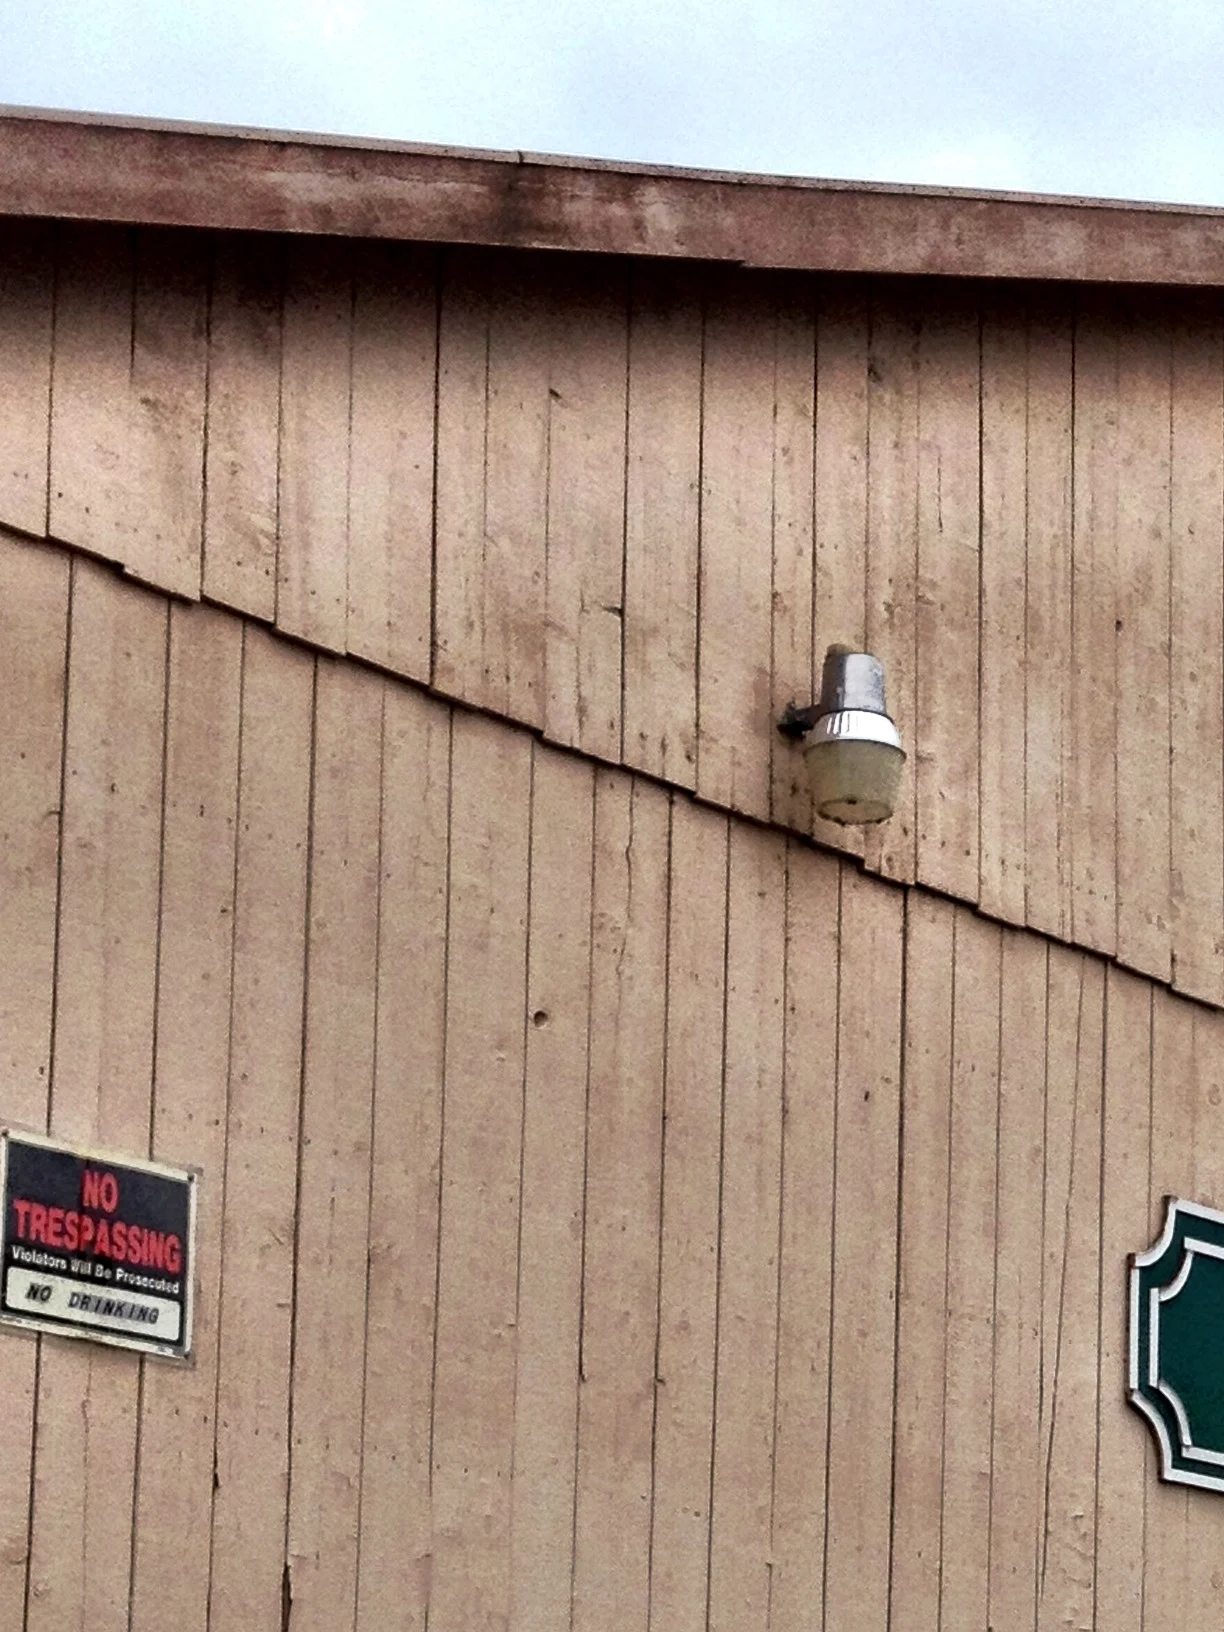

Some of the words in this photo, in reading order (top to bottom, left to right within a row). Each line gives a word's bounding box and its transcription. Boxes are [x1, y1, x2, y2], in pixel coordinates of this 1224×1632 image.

[82, 1170, 119, 1213] NO
[13, 1198, 181, 1274] TRESPASSING
[11, 1245, 67, 1270] Violators
[70, 1258, 92, 1276] Will
[95, 1264, 112, 1280] Be
[116, 1268, 180, 1295] Prosecuted
[25, 1282, 52, 1304] NO
[68, 1292, 159, 1325] DRINKING
